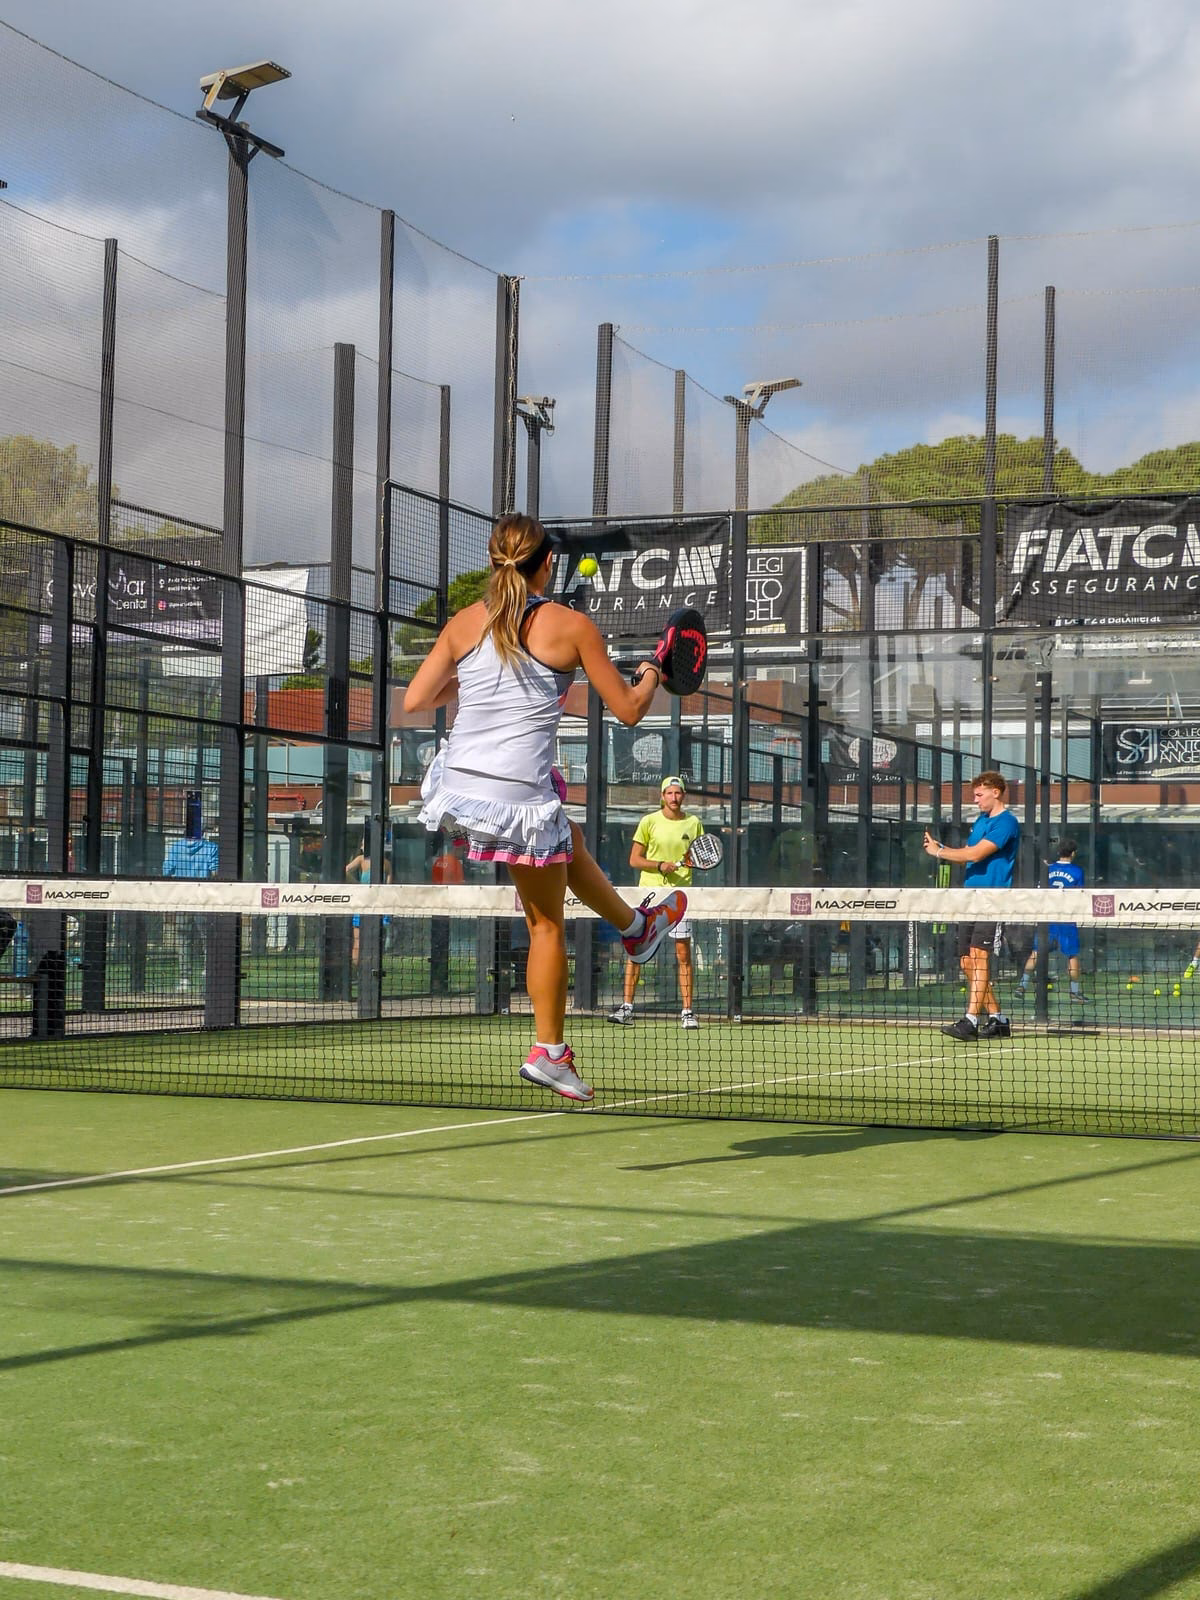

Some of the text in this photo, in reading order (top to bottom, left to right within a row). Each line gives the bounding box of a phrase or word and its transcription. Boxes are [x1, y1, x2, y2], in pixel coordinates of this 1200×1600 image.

[1011, 525, 1177, 574] FIATC
[552, 548, 671, 594] IATC
[747, 557, 783, 573] LEGI
[1011, 575, 1199, 595] ASSEGURANC
[116, 598, 148, 610] Dental
[568, 590, 718, 612] SURANCE
[45, 890, 109, 900] MAXPEED
[281, 894, 350, 903] MAXPEED
[814, 899, 897, 909] MAXPEED
